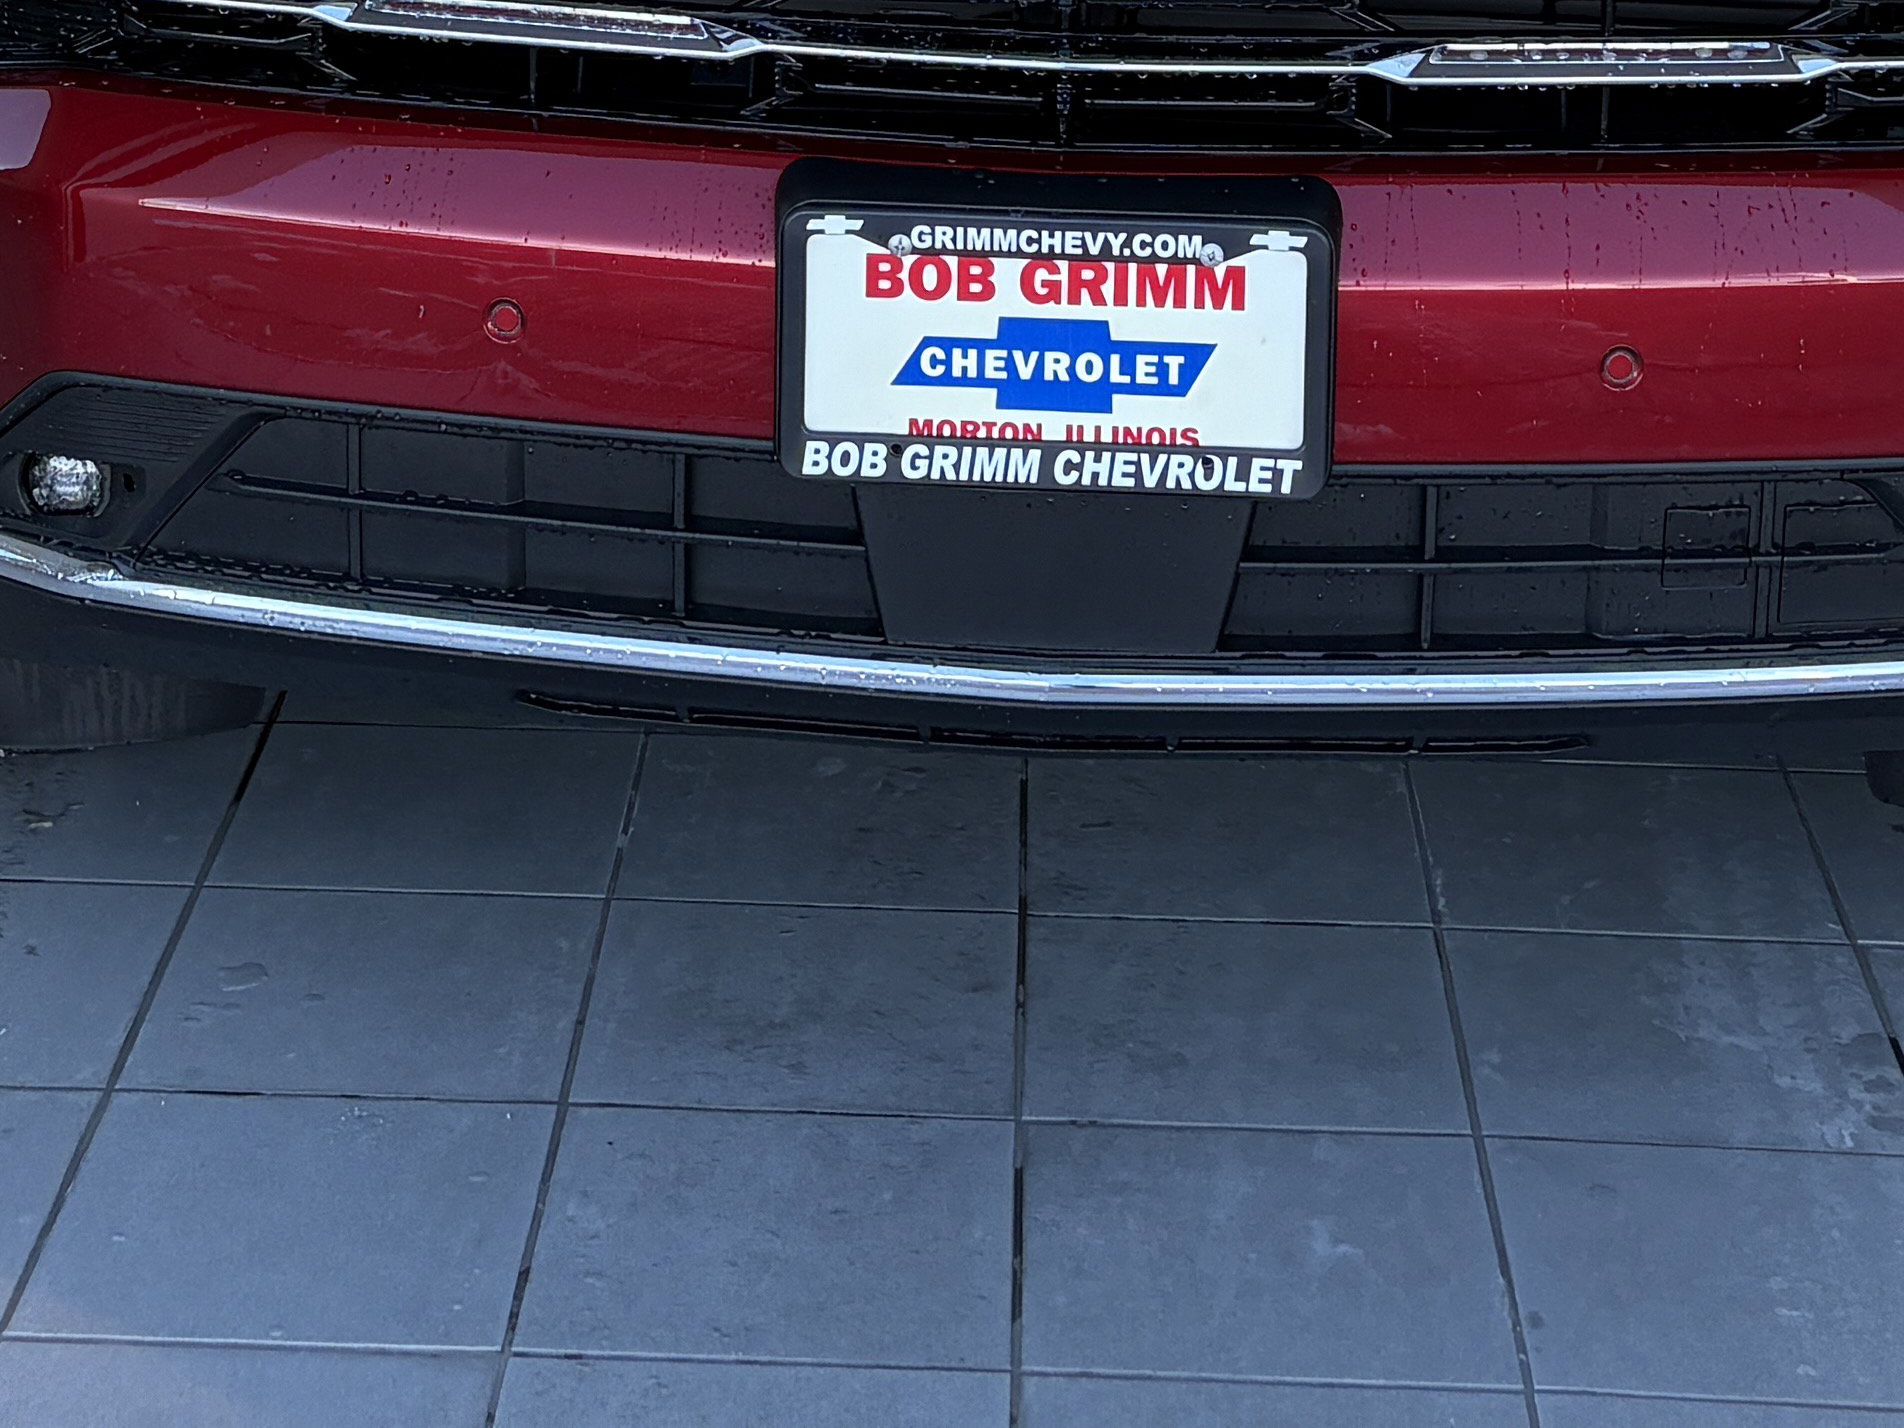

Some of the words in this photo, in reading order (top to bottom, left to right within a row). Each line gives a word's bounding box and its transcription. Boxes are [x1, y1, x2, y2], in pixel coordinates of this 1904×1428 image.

[910, 224, 1203, 259] GRIMMCHEVY.COM
[865, 253, 996, 302] BOB
[1019, 259, 1246, 312] GRIMM
[919, 346, 1185, 386] CHEVROLET
[801, 440, 888, 478] BOB
[900, 443, 1042, 484] GRIMM
[1053, 449, 1303, 495] CHEVROLET
